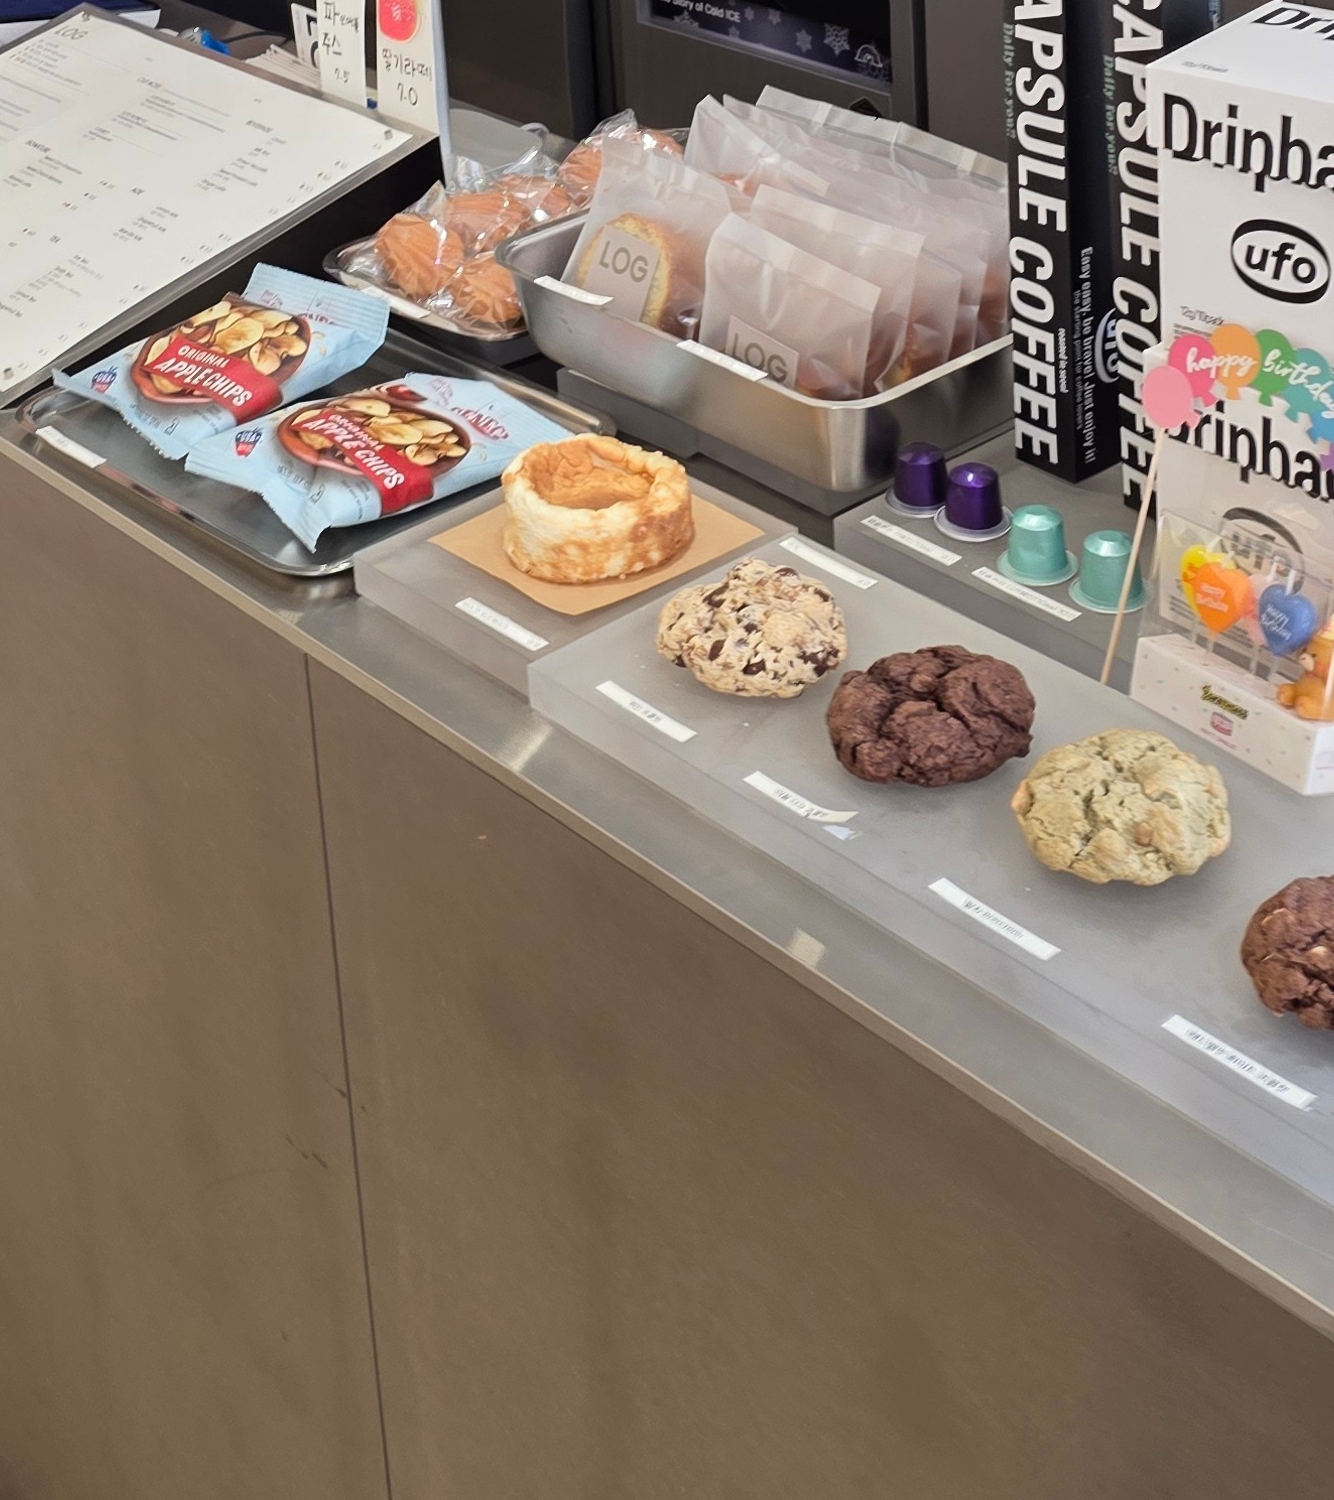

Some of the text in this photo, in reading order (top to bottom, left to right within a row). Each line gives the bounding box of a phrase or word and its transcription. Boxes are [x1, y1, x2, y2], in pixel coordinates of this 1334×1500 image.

[695, 1, 704, 12] of
[705, 4, 725, 19] Cold
[726, 9, 742, 24] ICE
[54, 25, 90, 41] LOG
[322, 32, 343, 56] 주스
[1003, 22, 1015, 67] Daily
[382, 48, 433, 82] 딸기라떼
[1103, 55, 1116, 101] Daily
[396, 82, 419, 106] 7.0
[598, 240, 649, 282] LOG
[1243, 240, 1317, 286] ufo
[1082, 316, 1095, 336] be
[177, 345, 231, 369] ORIGINAL
[733, 333, 788, 383] LOG
[1009, 236, 1059, 465] COFFEE
[1185, 346, 1259, 380] happy
[154, 358, 253, 406] APPLE CHIPS
[1083, 381, 1096, 411] Just
[328, 413, 385, 451] ORIGINAL
[1082, 411, 1097, 447] enjoy
[302, 419, 405, 490] APPLE CHIPS
